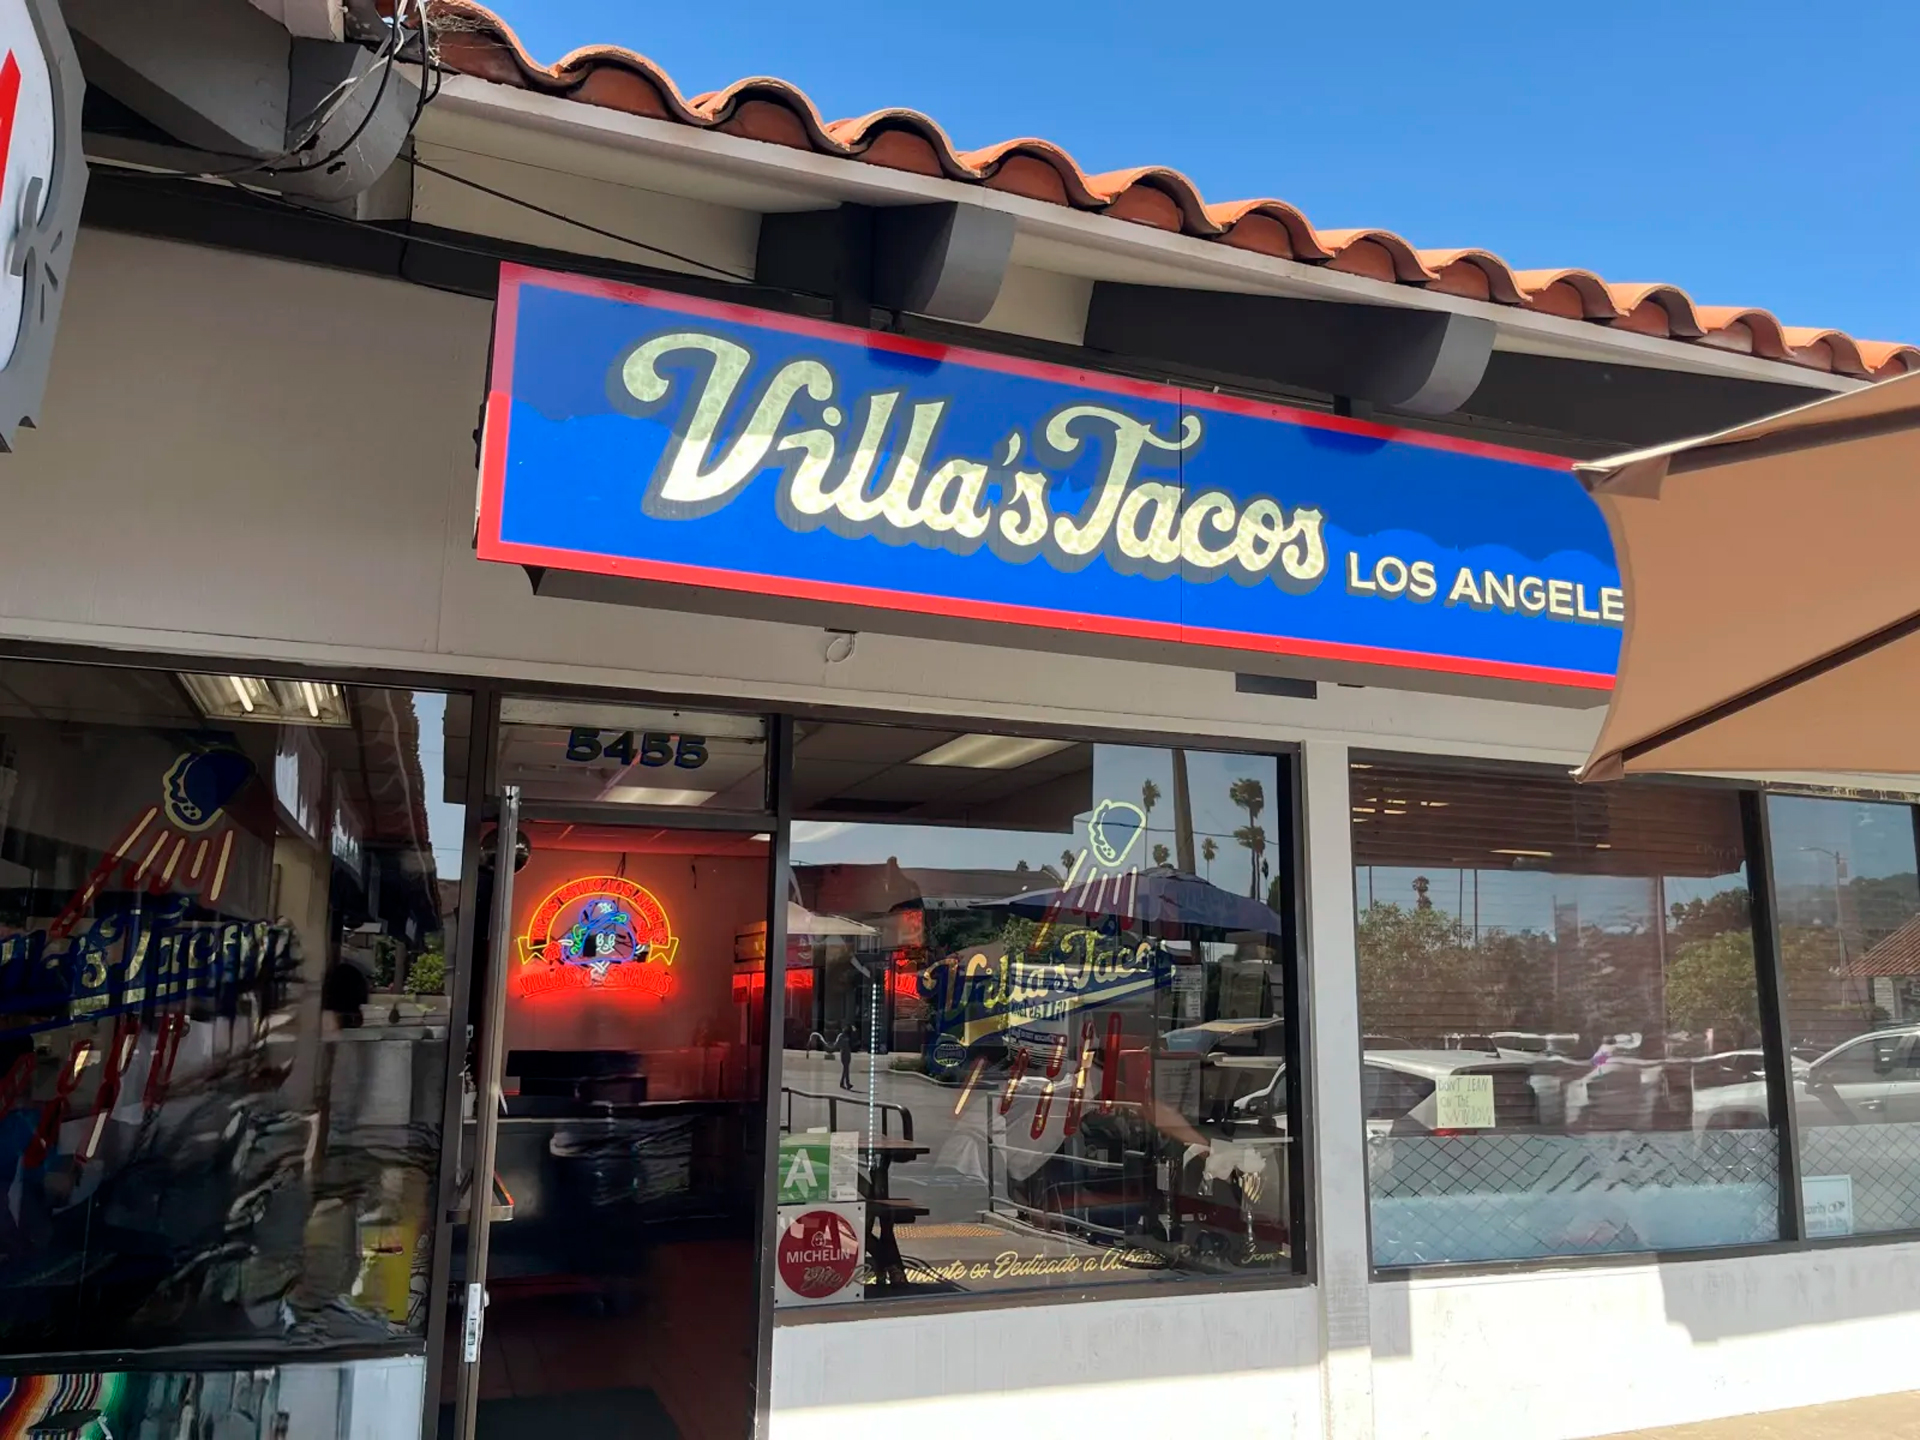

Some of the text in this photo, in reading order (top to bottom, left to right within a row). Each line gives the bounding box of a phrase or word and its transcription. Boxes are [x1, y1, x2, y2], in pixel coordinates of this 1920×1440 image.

[622, 333, 1325, 579] Villa's Tacos
[1349, 551, 1625, 622] LOS ANGELE
[566, 727, 709, 769] 5455
[532, 878, 668, 945] TACOS ESTILO LOS ANGELES
[623, 966, 673, 994] TACOS
[783, 1147, 818, 1189] A
[786, 1248, 851, 1264] MICHELIN
[993, 1250, 1081, 1279] Dedicado
[1083, 1256, 1099, 1273] a
